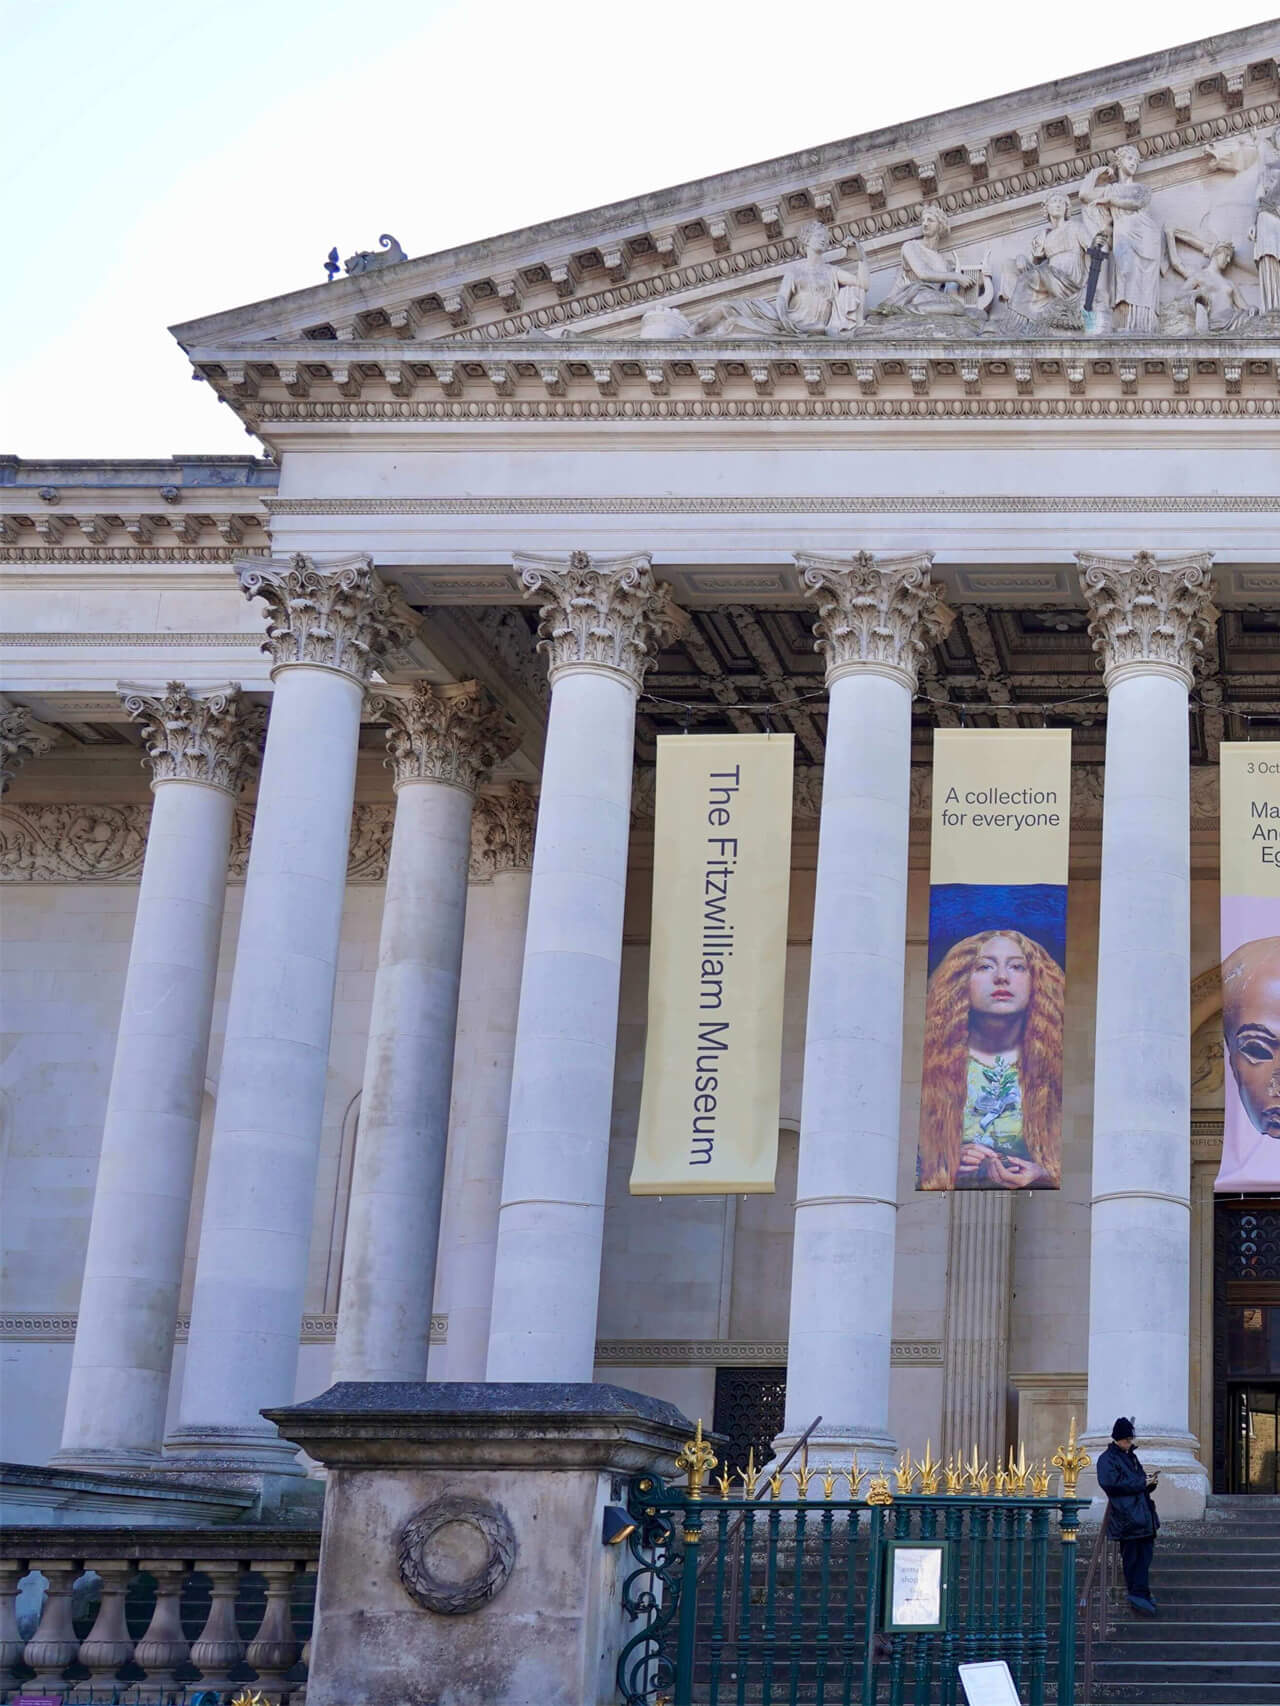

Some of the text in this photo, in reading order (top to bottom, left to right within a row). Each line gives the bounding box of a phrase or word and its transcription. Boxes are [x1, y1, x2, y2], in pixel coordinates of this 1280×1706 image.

[1247, 762, 1255, 774] 3
[944, 786, 1057, 805] A collection
[942, 808, 1060, 832] for everyone
[689, 764, 740, 1166] The Fitzwilliam Museum
